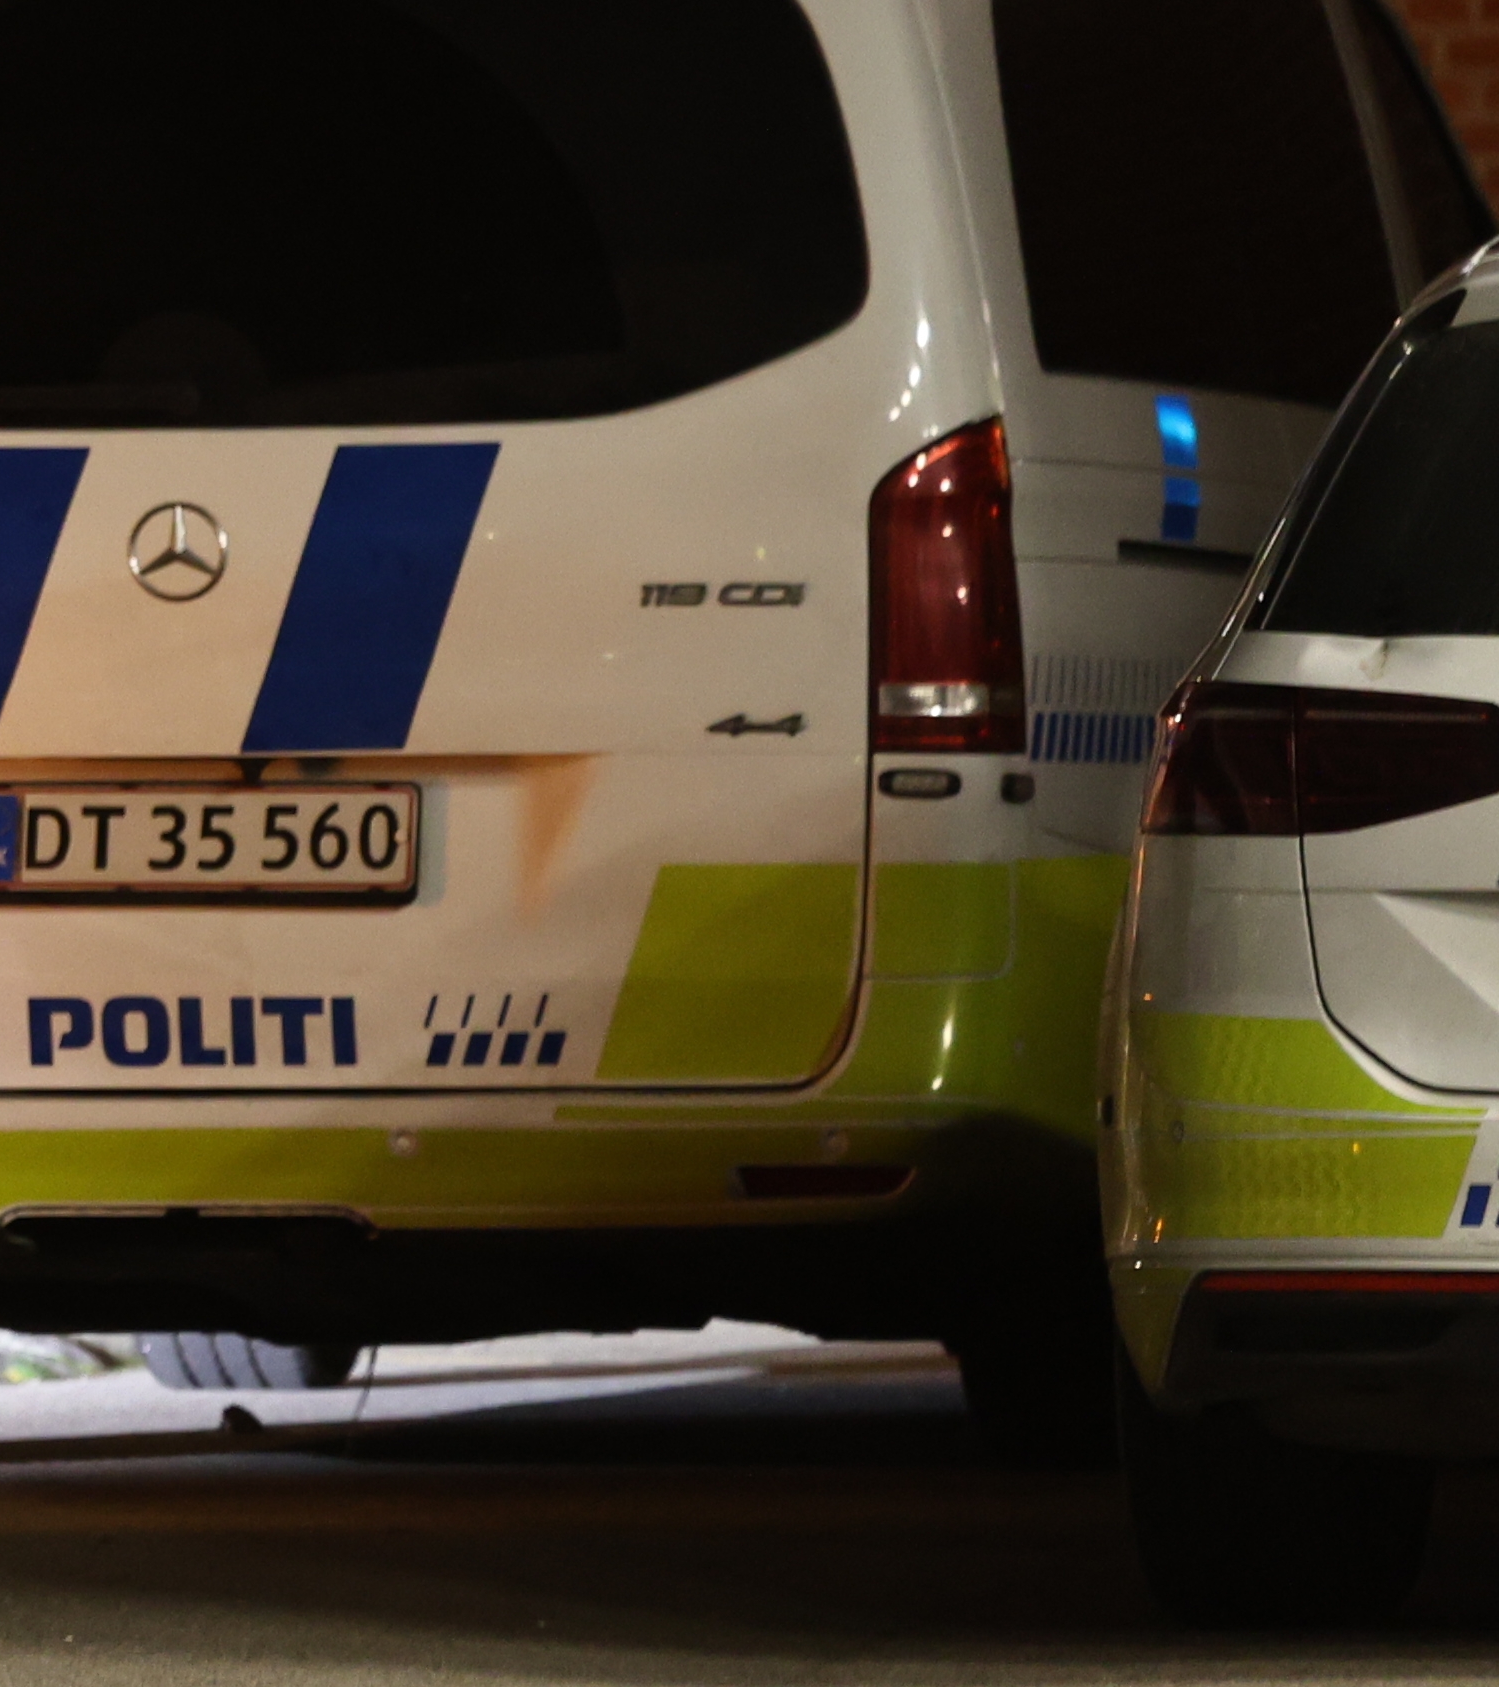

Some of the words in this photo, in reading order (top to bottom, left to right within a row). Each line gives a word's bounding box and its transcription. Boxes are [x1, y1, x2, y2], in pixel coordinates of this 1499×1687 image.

[718, 581, 804, 607] CDI
[25, 806, 125, 870] DT
[147, 806, 235, 870] 35
[261, 803, 399, 870] 560
[28, 997, 359, 1067] POLITI
